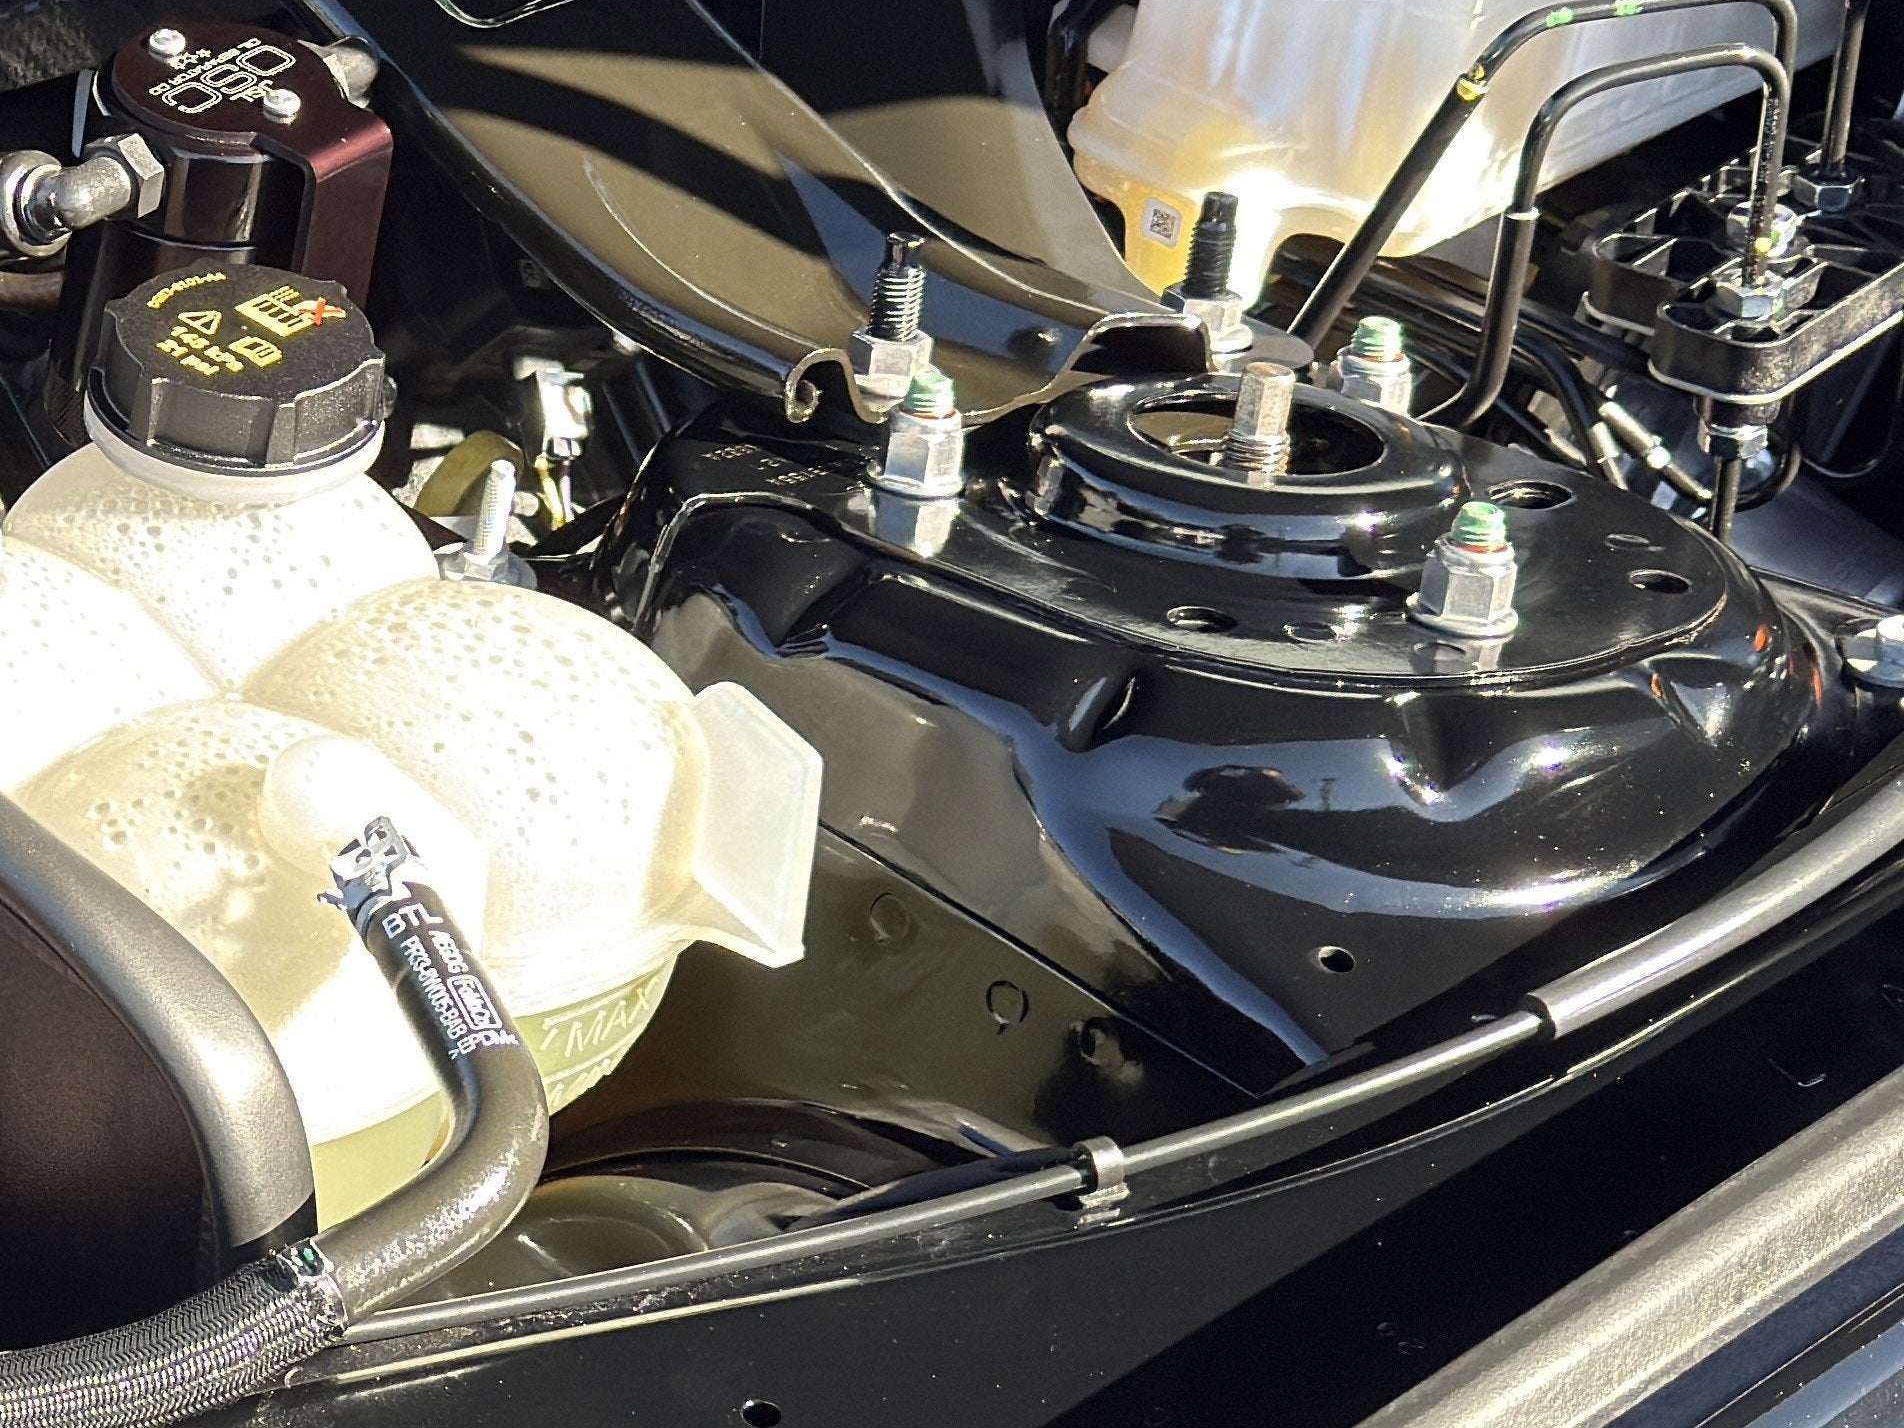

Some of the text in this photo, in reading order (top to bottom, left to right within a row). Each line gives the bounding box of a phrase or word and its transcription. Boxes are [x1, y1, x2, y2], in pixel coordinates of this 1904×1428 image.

[161, 44, 297, 114] OSC
[381, 903, 444, 940] BTL
[564, 977, 660, 1058] MAX
